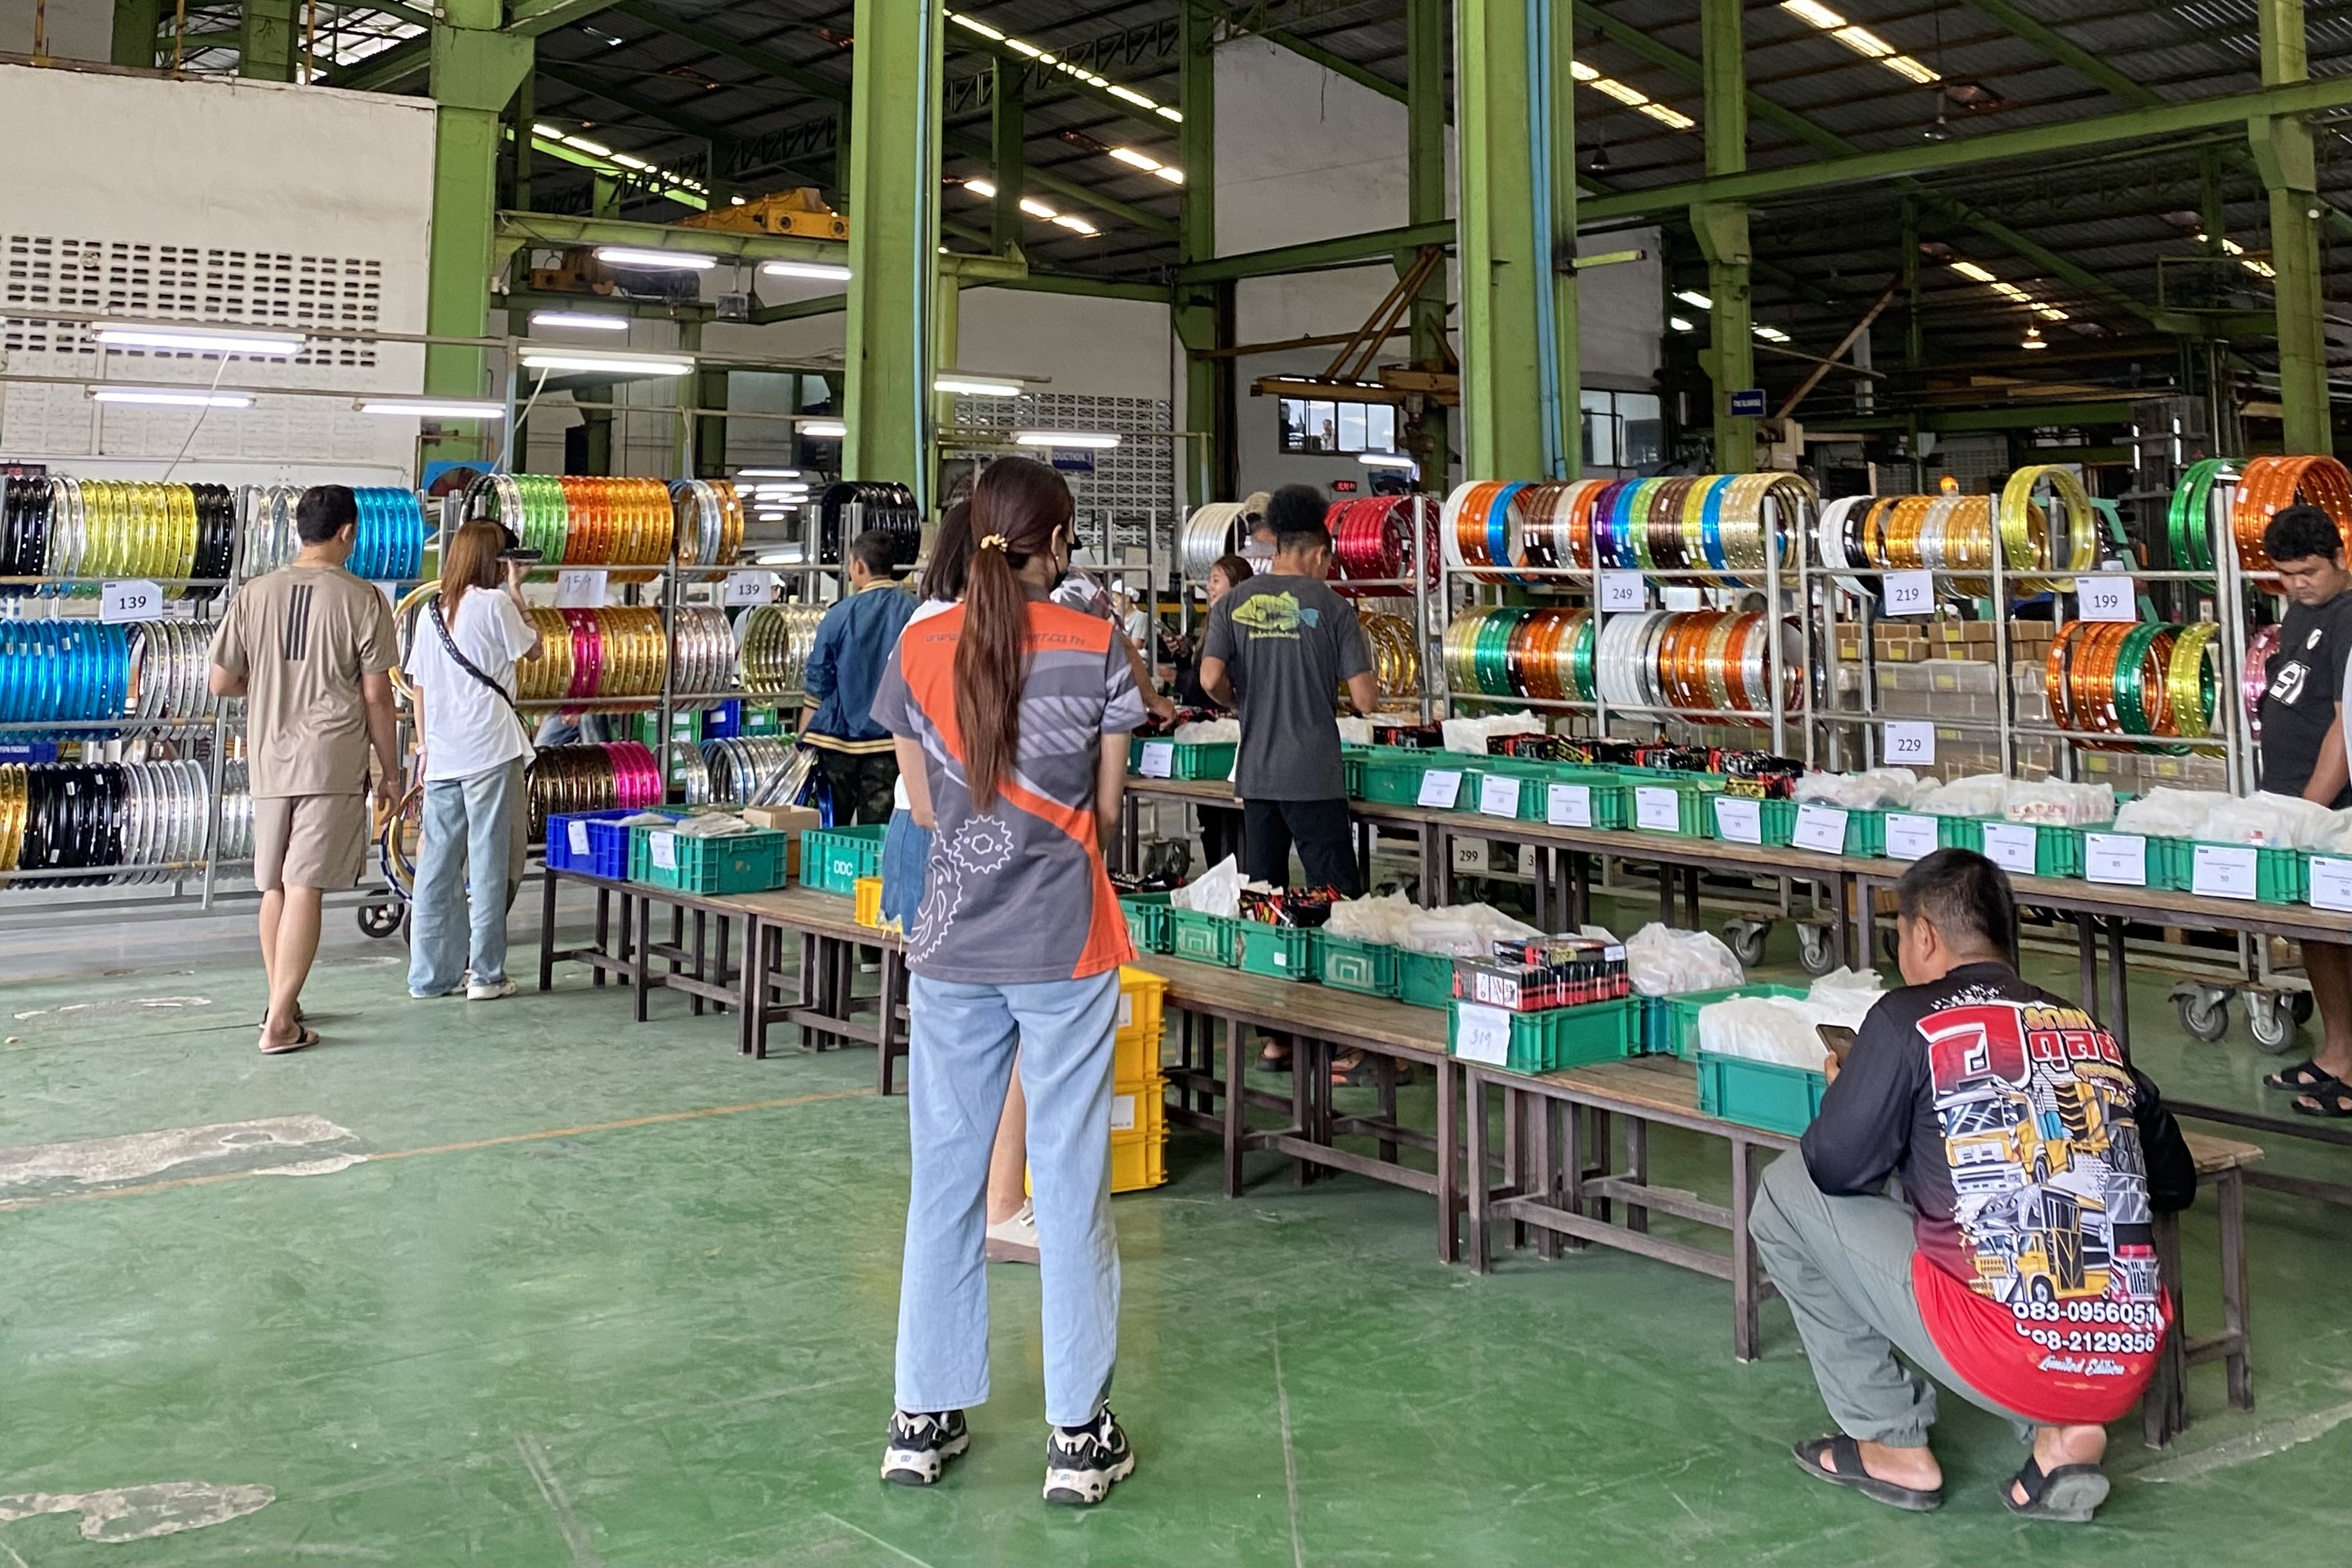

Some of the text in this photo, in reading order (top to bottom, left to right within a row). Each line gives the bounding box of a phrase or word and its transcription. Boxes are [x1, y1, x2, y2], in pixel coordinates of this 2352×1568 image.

[739, 584, 760, 595] 139
[1612, 588, 1633, 600] 249
[1896, 588, 1919, 602] 219
[119, 595, 147, 610] 139
[2093, 594, 2118, 608] 199
[1898, 739, 1921, 752] 229
[1460, 850, 1478, 862] 299
[834, 860, 853, 877] DDC
[1469, 1028, 1492, 1047] 319
[2012, 1300, 2156, 1326] 083-0956051
[2016, 1322, 2156, 1353] 8-2129356
[2038, 1355, 2125, 1376] Limited Edition
